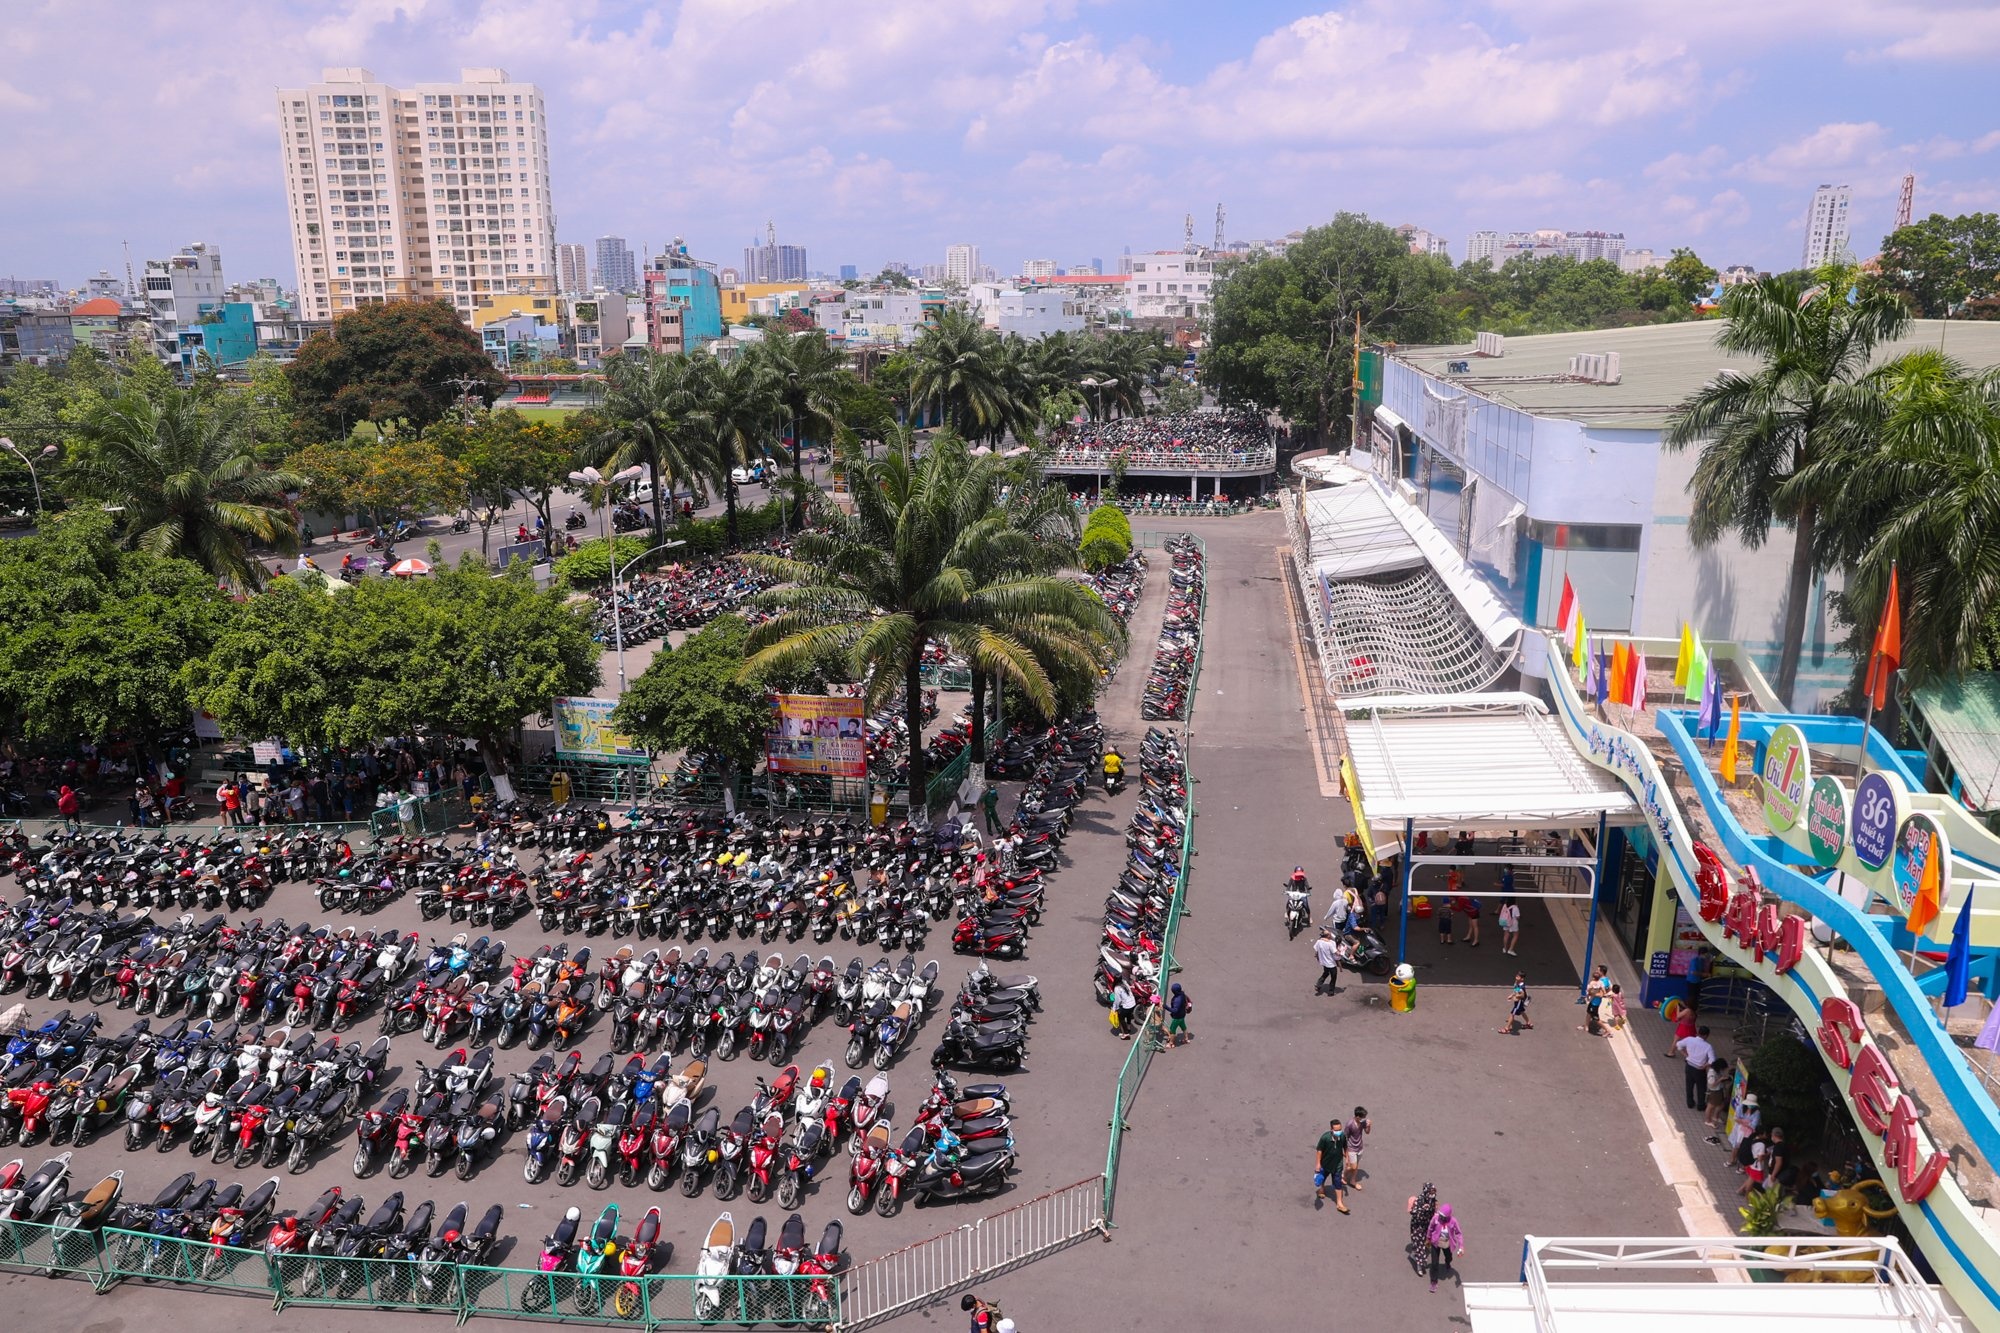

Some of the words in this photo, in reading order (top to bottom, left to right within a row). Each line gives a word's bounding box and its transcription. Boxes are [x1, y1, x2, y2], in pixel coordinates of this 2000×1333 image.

[1766, 755, 1783, 789] Chỉ
[1781, 744, 1800, 795] 1
[1789, 780, 1803, 804] vé
[1861, 788, 1891, 829] 36
[1821, 824, 1841, 854] ngày
[1856, 834, 1869, 849] trò
[1868, 843, 1884, 860] chơi
[1860, 822, 1877, 840] thiết
[1877, 832, 1886, 848] bị
